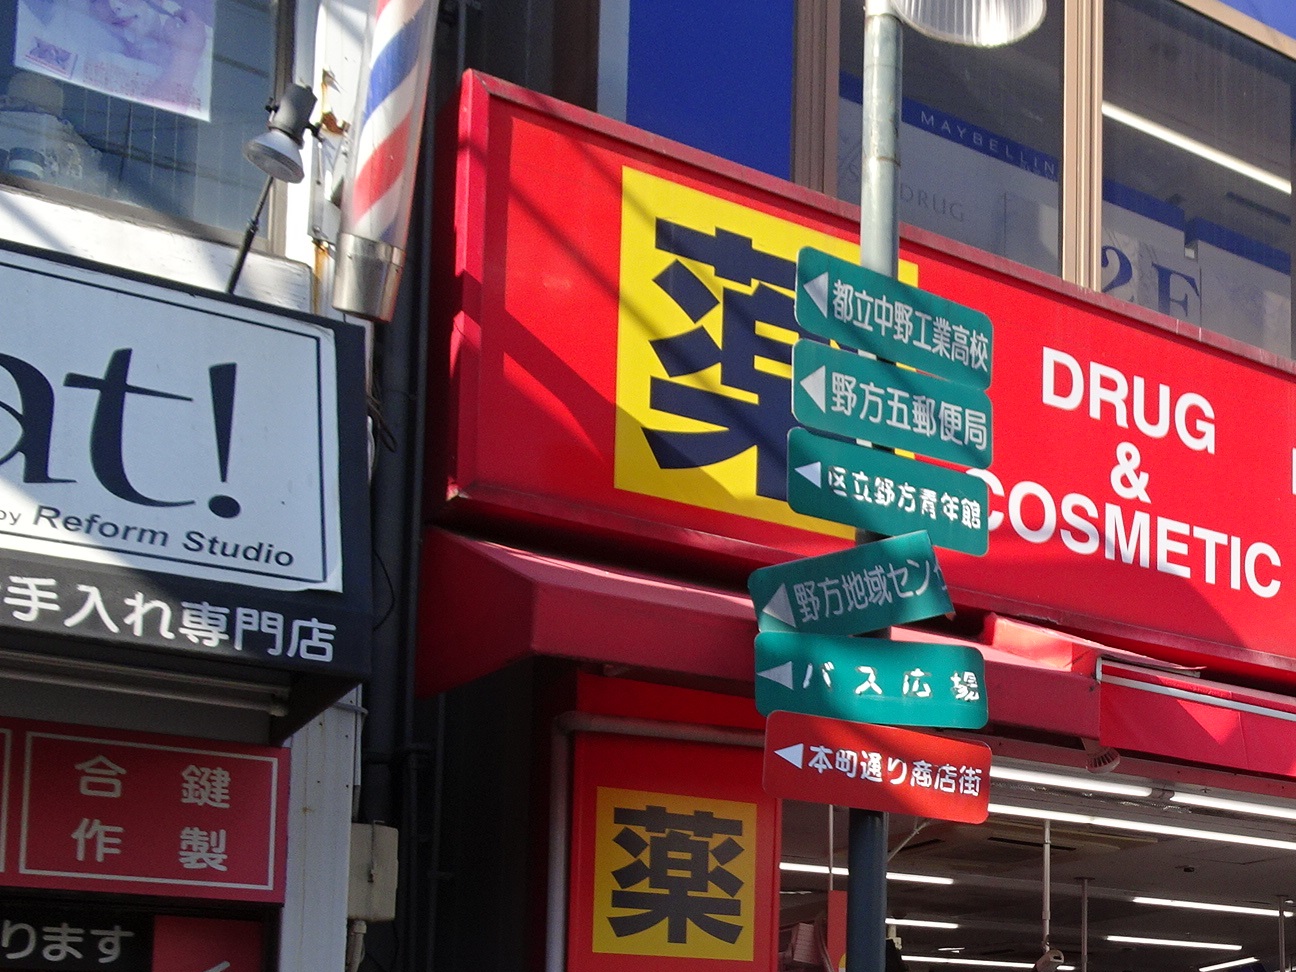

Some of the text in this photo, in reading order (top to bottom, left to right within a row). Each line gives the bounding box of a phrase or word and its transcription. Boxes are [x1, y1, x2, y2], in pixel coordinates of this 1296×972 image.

[832, 279, 989, 373] 都立中野工業高校
[830, 371, 988, 451] 野方五郵便局
[1042, 346, 1215, 454] DRUG
[827, 465, 982, 530] 区立野方青年館
[1110, 441, 1151, 504] &
[33, 505, 169, 547] Reform
[182, 531, 294, 567] Studio
[966, 468, 1282, 598] COSMETIC
[803, 661, 980, 702] バス広場
[808, 744, 983, 797] 本町通り商店街
[607, 805, 745, 945] 薬
